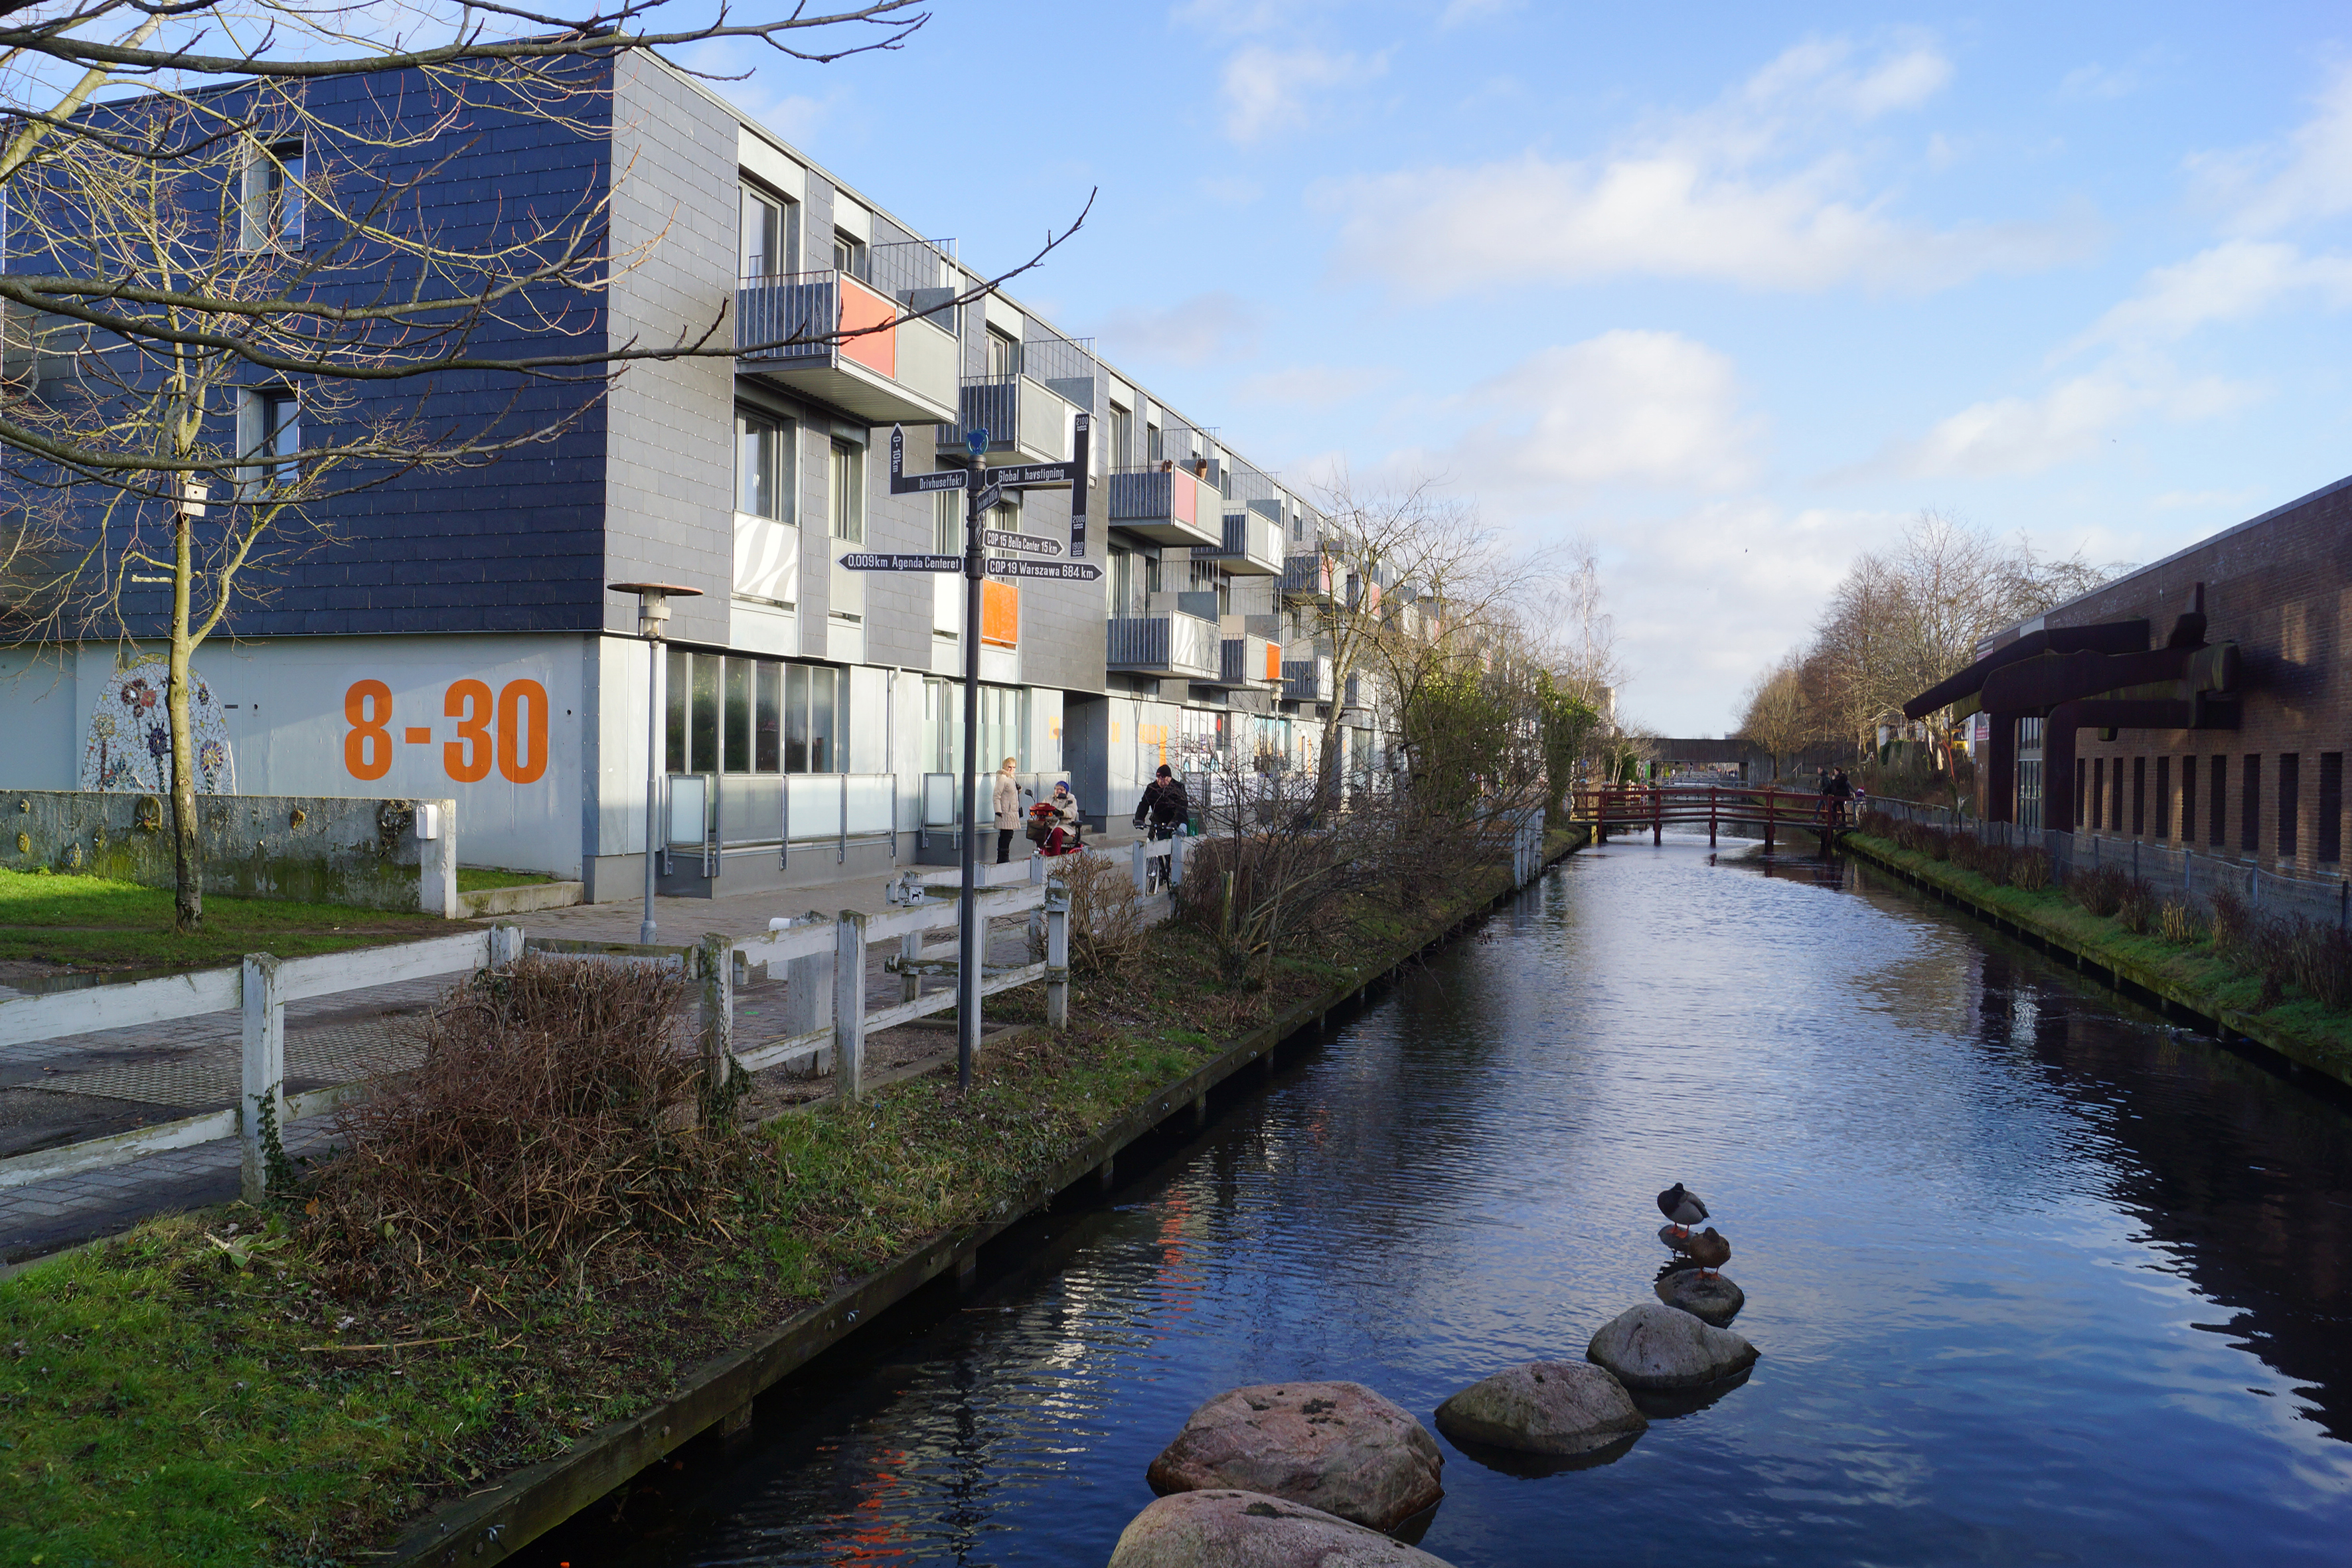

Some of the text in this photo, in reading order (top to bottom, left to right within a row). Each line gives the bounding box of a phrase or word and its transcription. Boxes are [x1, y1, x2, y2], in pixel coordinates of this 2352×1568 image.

[1076, 416, 1089, 426] 2100
[919, 474, 963, 490] Drivhuseffekt
[998, 467, 1065, 483] Global havstigning
[1072, 514, 1085, 524] 2000
[986, 532, 999, 546] COP
[999, 534, 1007, 549] 15
[1008, 536, 1022, 550] Bella
[1022, 537, 1040, 552] Center
[1071, 541, 1084, 550] 1900
[892, 555, 923, 570] Agenda
[925, 556, 959, 570] Centeret
[990, 560, 1093, 580] COP 19 Warszawa 684 km
[344, 678, 549, 784] 8-30
[1111, 721, 1121, 743] 30
